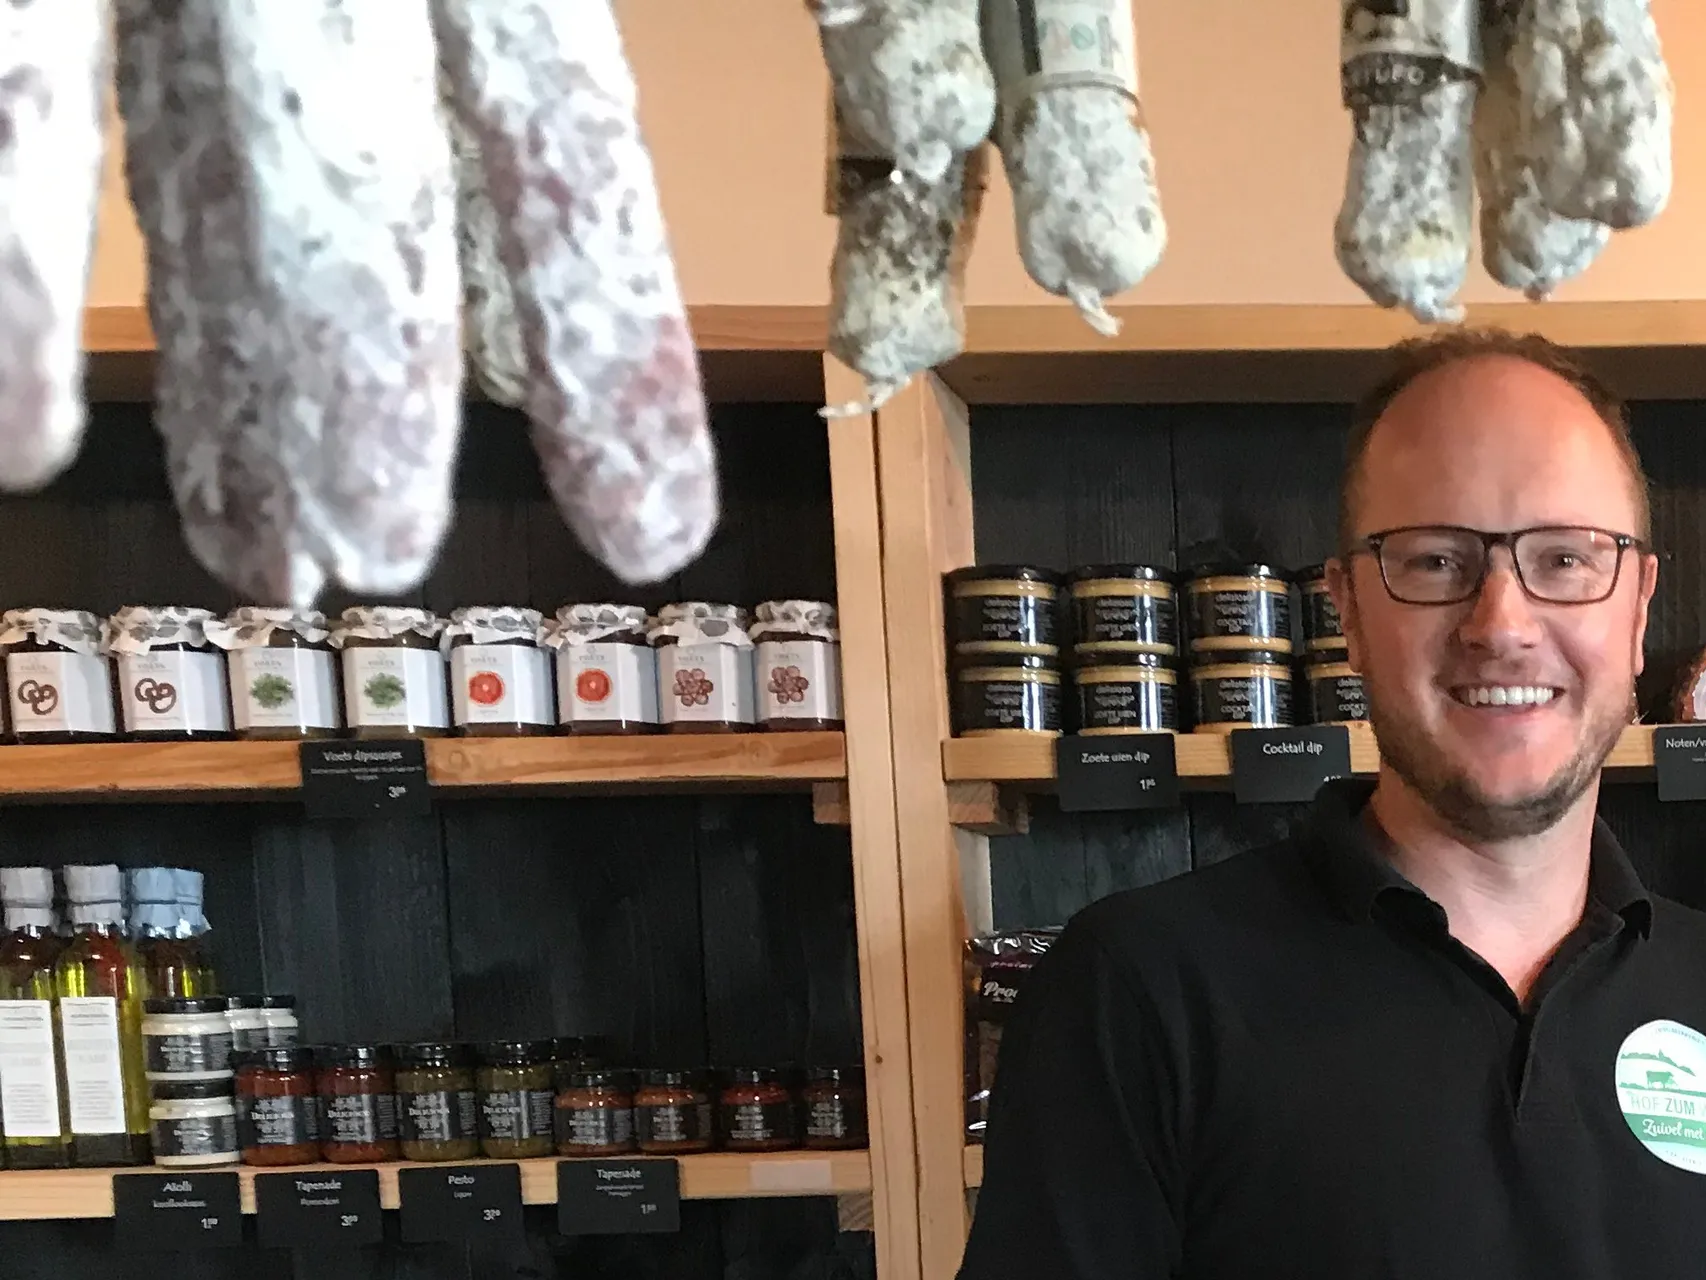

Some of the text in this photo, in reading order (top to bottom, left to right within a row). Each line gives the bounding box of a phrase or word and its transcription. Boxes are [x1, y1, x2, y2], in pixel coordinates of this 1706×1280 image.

[1263, 741, 1323, 756] Cocktail dip
[1082, 752, 1150, 765] Zoete uien dip
[1665, 1097, 1695, 1116] ZUM
[1642, 1118, 1683, 1137] Zuivel
[1684, 1127, 1704, 1141] met
[448, 1175, 475, 1187] Pesto
[597, 1168, 641, 1181] Tapenade
[296, 1179, 342, 1191] Tapenade
